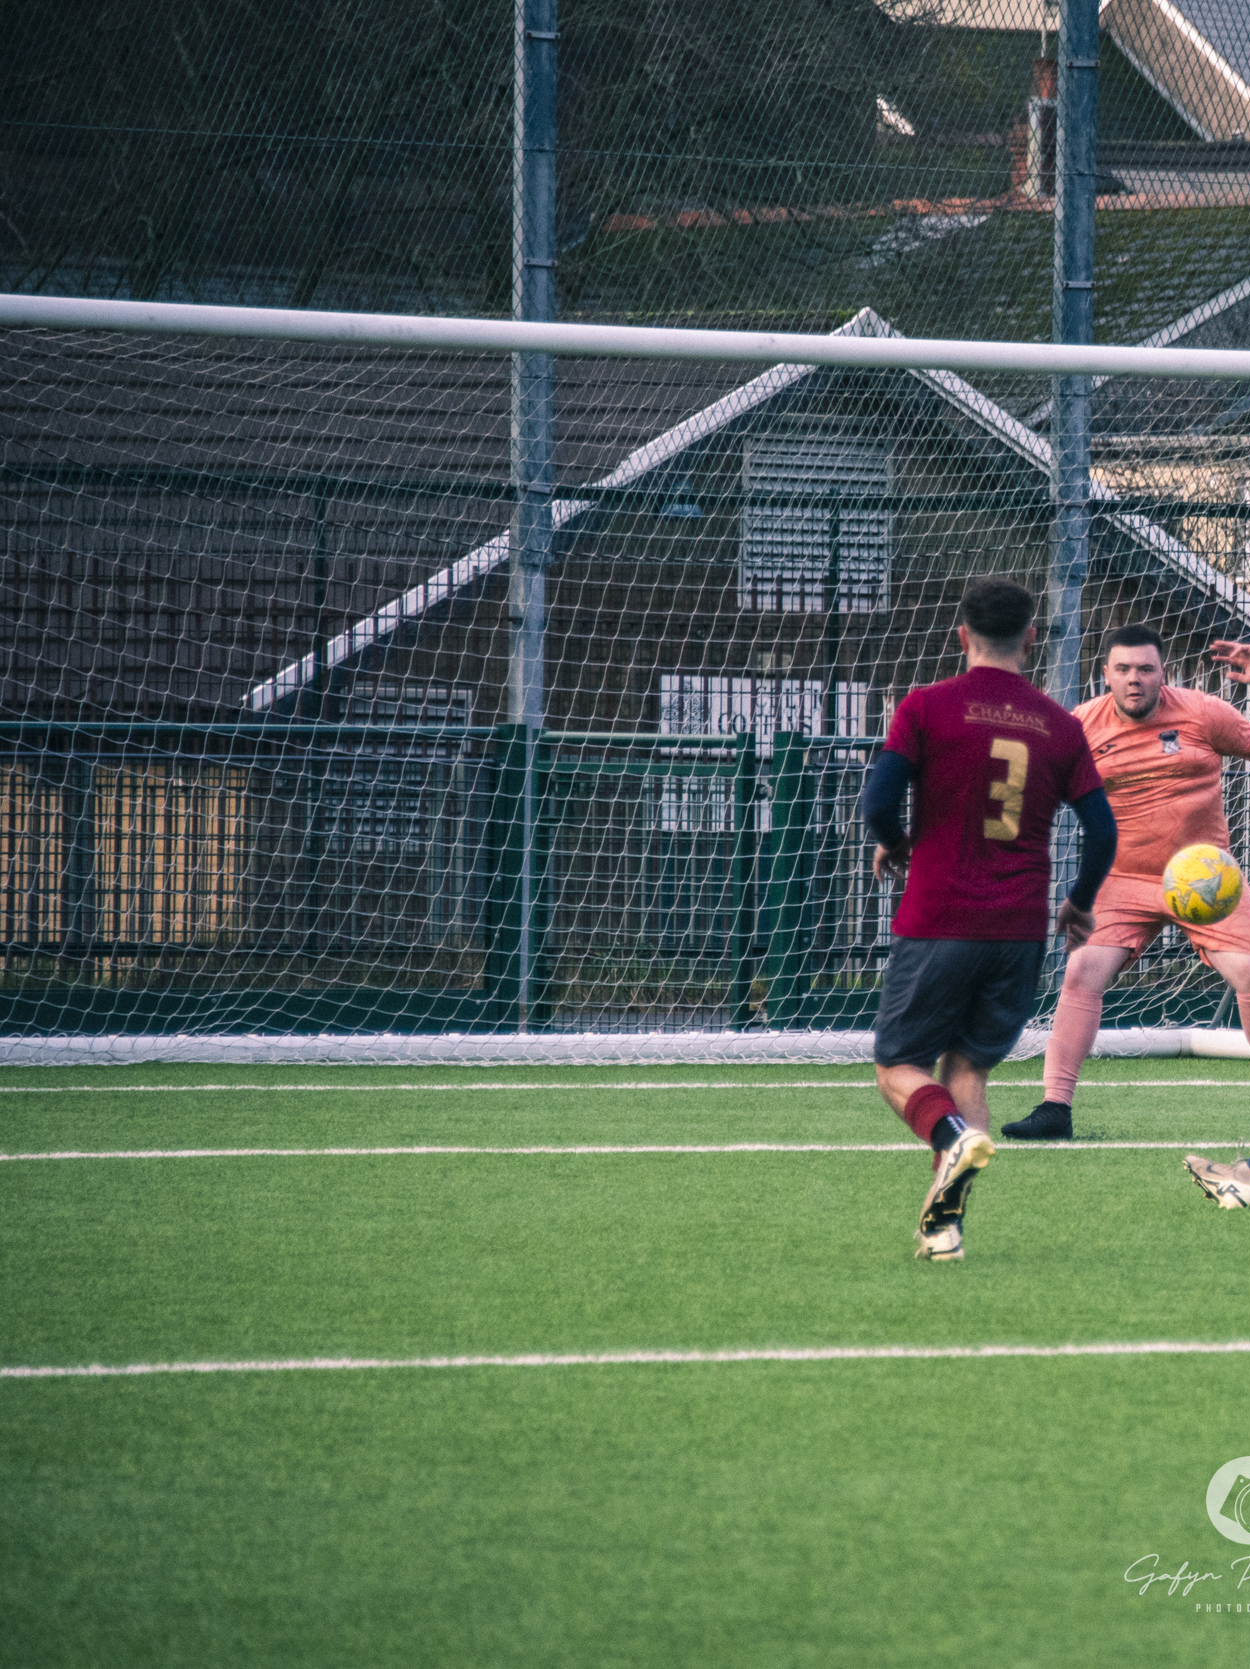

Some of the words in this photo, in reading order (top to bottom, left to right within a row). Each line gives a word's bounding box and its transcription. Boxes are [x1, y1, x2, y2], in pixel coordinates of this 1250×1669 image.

[755, 685, 825, 709] CLI
[968, 704, 1046, 728] CHAPMAN
[983, 738, 1029, 841] 3
